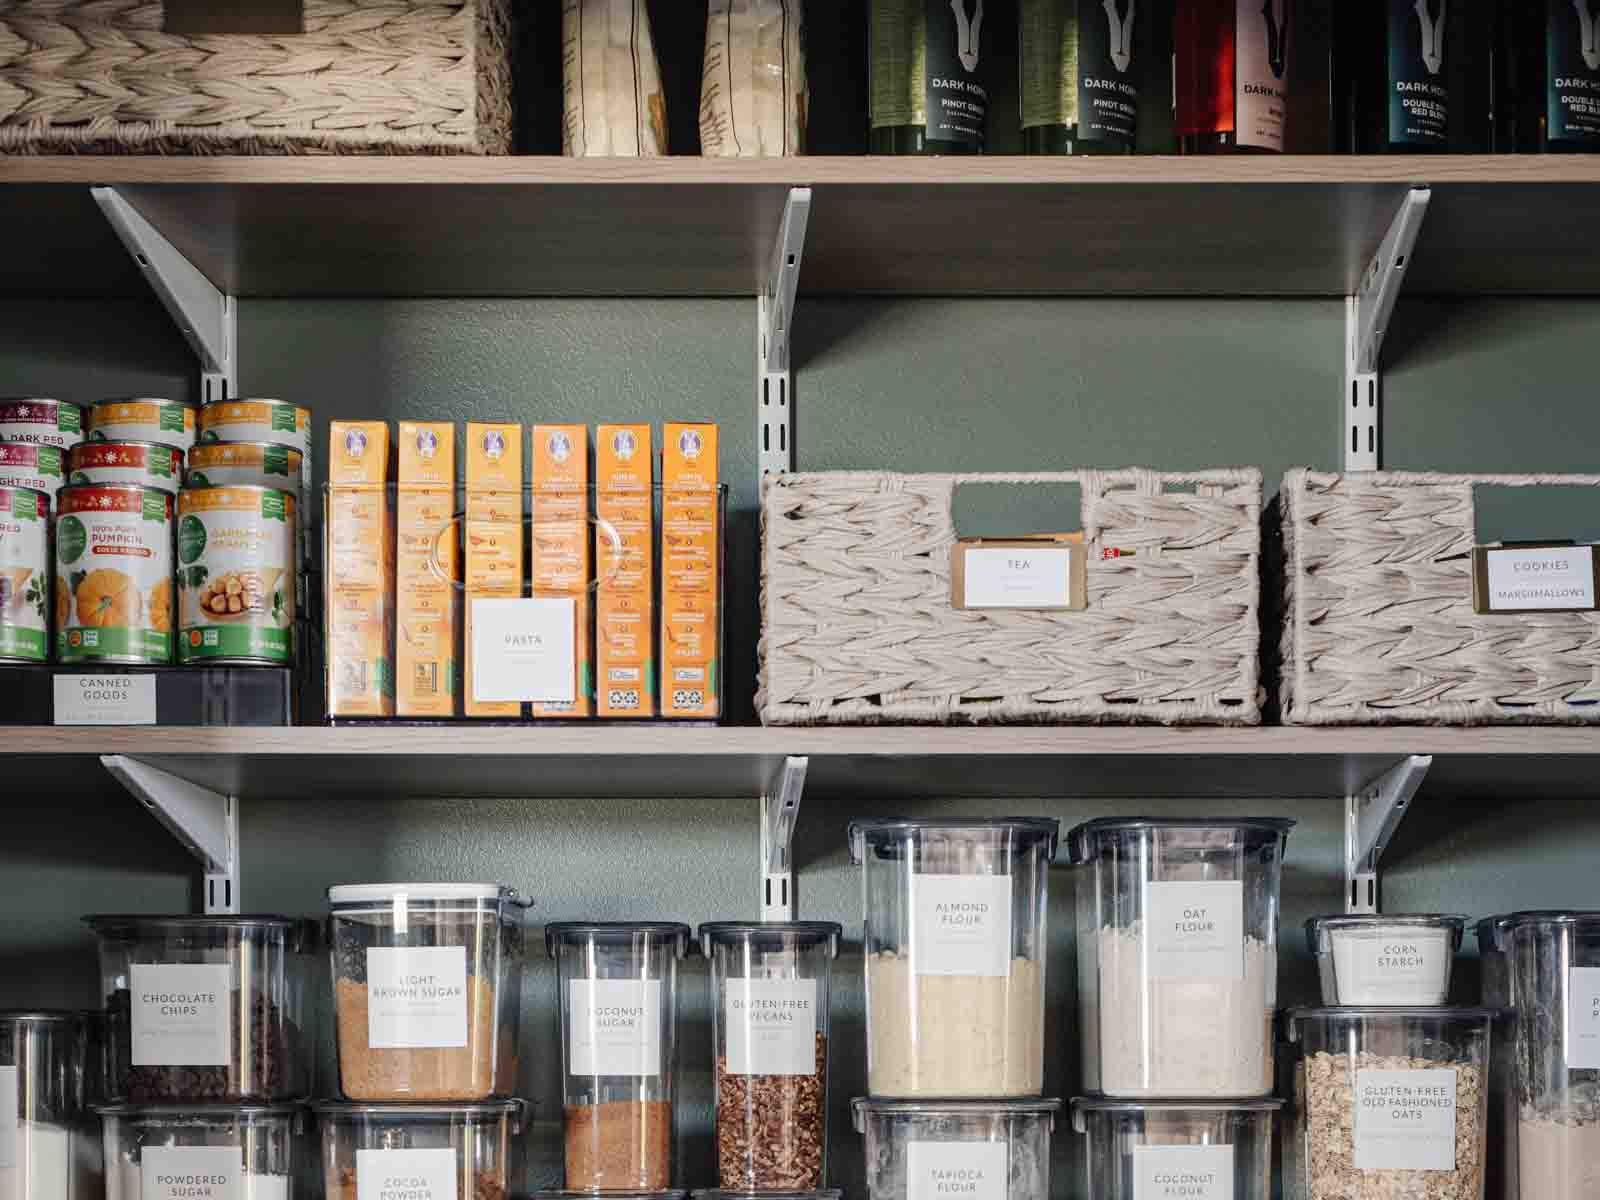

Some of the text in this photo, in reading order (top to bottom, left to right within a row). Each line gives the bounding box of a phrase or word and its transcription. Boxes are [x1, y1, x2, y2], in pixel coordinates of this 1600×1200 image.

[933, 78, 964, 90] DARK
[1084, 78, 1117, 90] DARK
[1396, 81, 1429, 93] DARK
[1554, 78, 1589, 89] DARK
[1244, 84, 1273, 97] DARK
[942, 98, 967, 109] PINOT
[1094, 98, 1119, 110] PINOT
[1411, 107, 1428, 117] RED
[11, 434, 41, 444] DARK
[91, 534, 143, 545] PUMPKIN
[1007, 559, 1031, 569] TEA
[1512, 559, 1569, 572] COOKIES
[1497, 587, 1585, 602] MARSHMALLOWS
[504, 633, 543, 646] PASTA
[79, 678, 131, 688] CANNED
[83, 690, 129, 700] GOODS
[935, 903, 989, 913] ALMOND
[1183, 909, 1206, 919] OAT
[940, 915, 981, 925] FLOUR
[1175, 920, 1215, 932] FLOUR
[1383, 944, 1417, 954] CORN
[1377, 956, 1424, 967] STARCH
[399, 975, 435, 985] LIGHT
[142, 993, 216, 1003] CHOCOLATE
[373, 986, 461, 999] BROWN SUGAR
[161, 1006, 197, 1016] CHIPS
[1364, 1086, 1448, 1097] GLUTEN FREE
[1362, 1097, 1452, 1107] OLD FASHIONED
[1391, 1109, 1424, 1120] OATS
[157, 1175, 227, 1186] POWDERED
[931, 1169, 985, 1181] TAPIOCA
[1153, 1174, 1216, 1186] COCONUT
[383, 1178, 428, 1188] COCOA
[937, 1182, 976, 1193] FLOUR
[170, 1187, 213, 1198] SUGAR
[379, 1190, 432, 1200] POWDER
[1164, 1186, 1205, 1197] FLOUR
